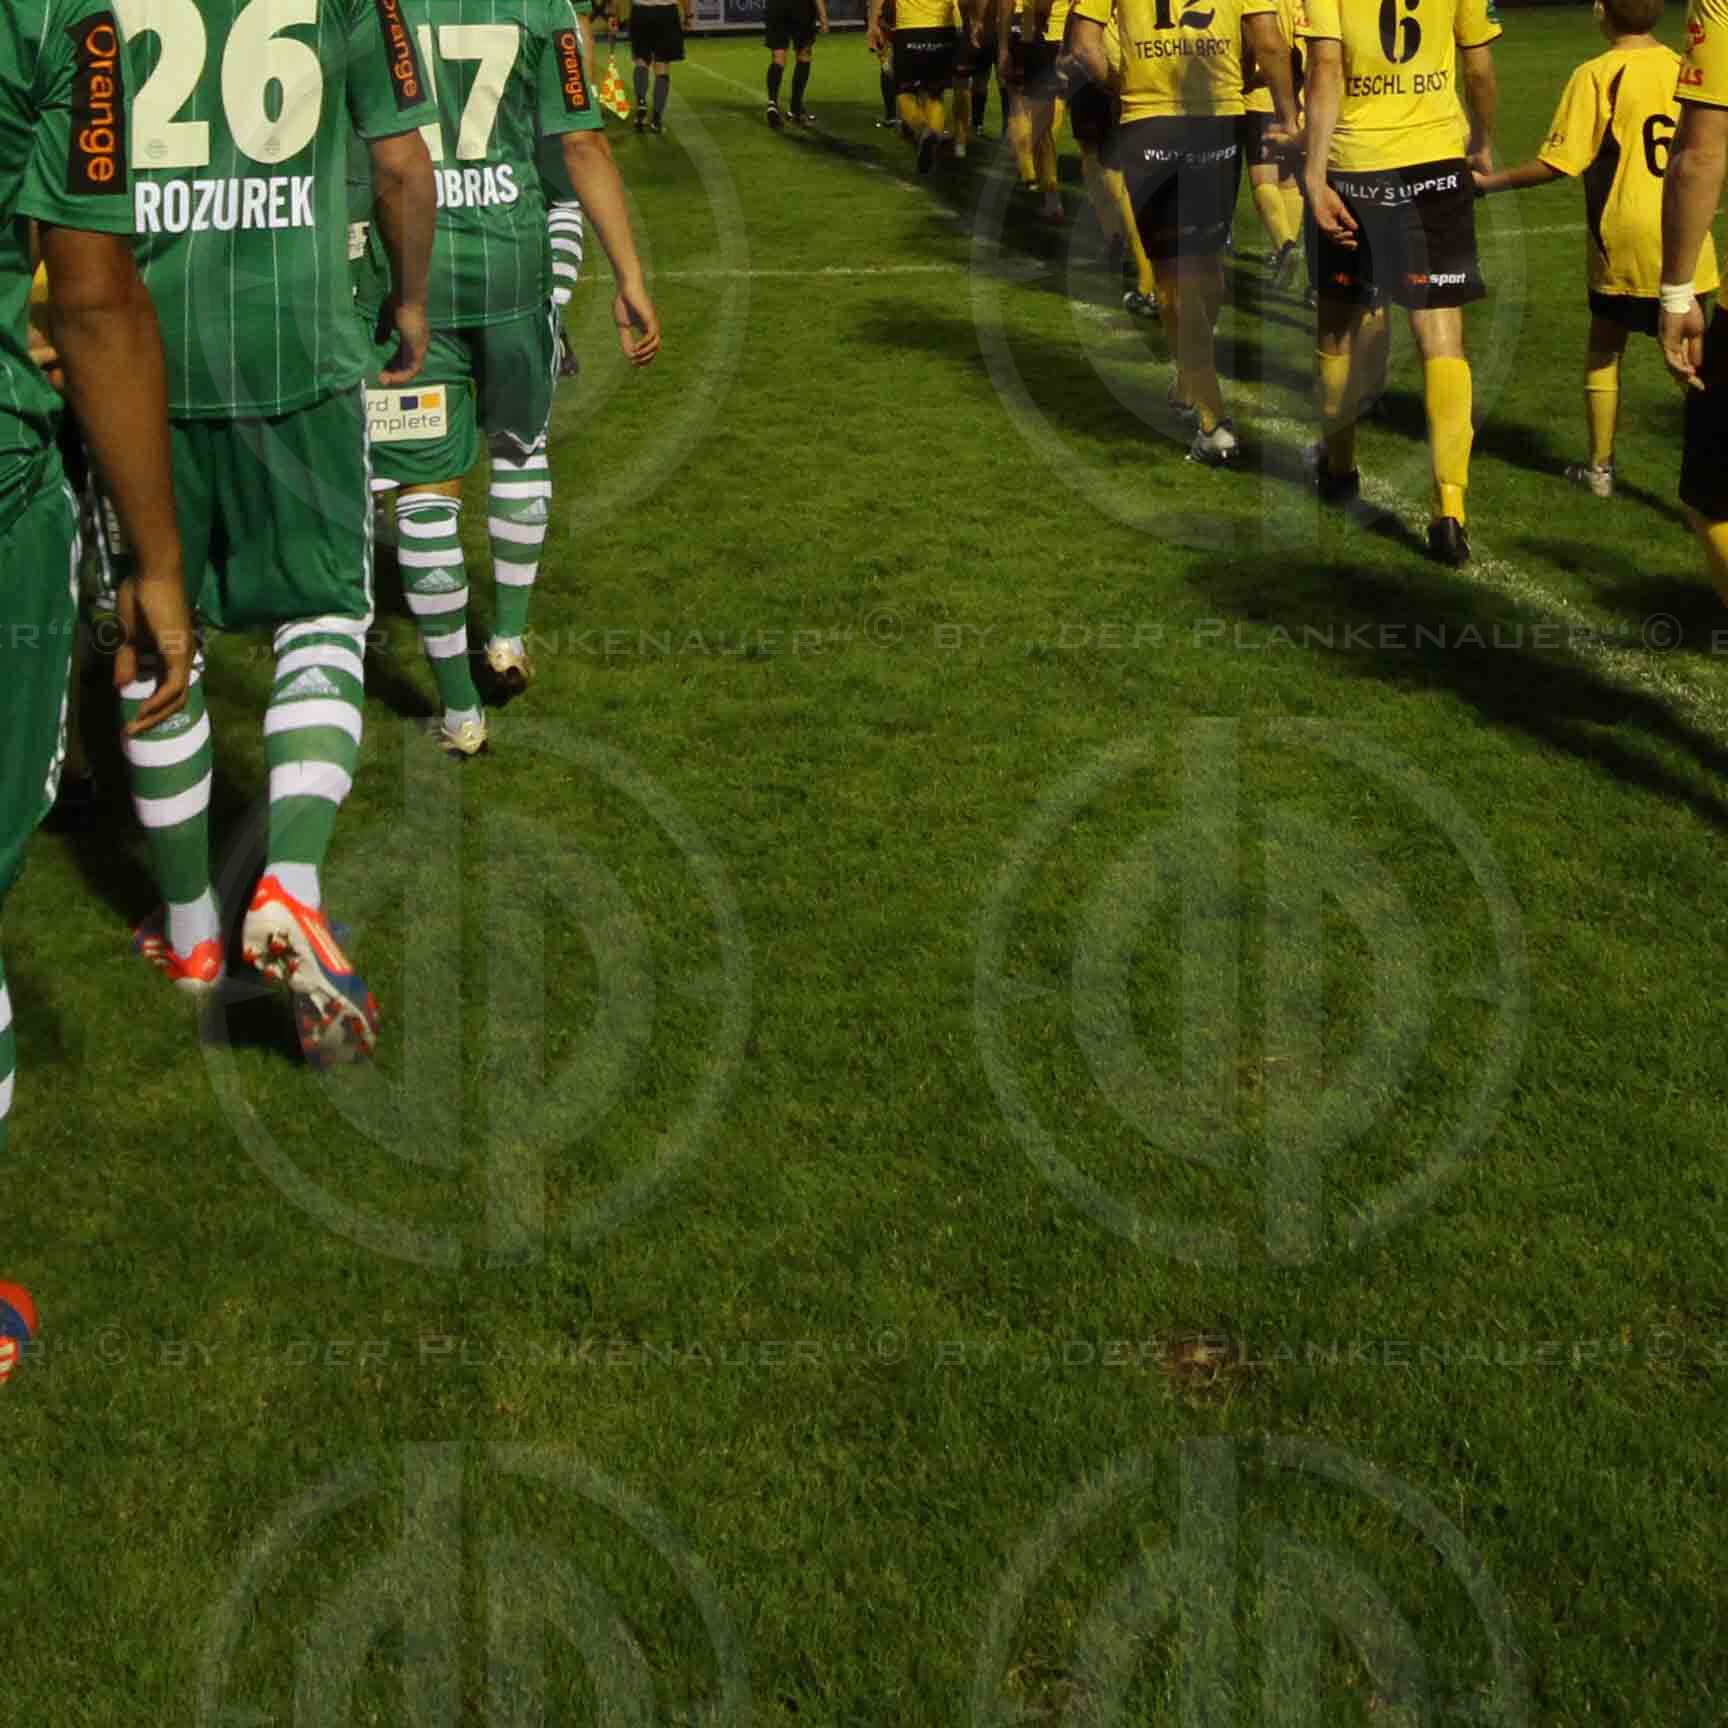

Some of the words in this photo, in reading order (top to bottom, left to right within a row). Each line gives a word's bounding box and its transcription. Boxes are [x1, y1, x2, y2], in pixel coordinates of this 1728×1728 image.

[560, 32, 585, 108] Orange
[1134, 39, 1193, 60] TESCHL
[78, 24, 118, 182] Orange
[1643, 114, 1676, 177] 6
[134, 175, 314, 234] ROZUREK
[367, 395, 389, 412] rd
[368, 415, 441, 434] mplete
